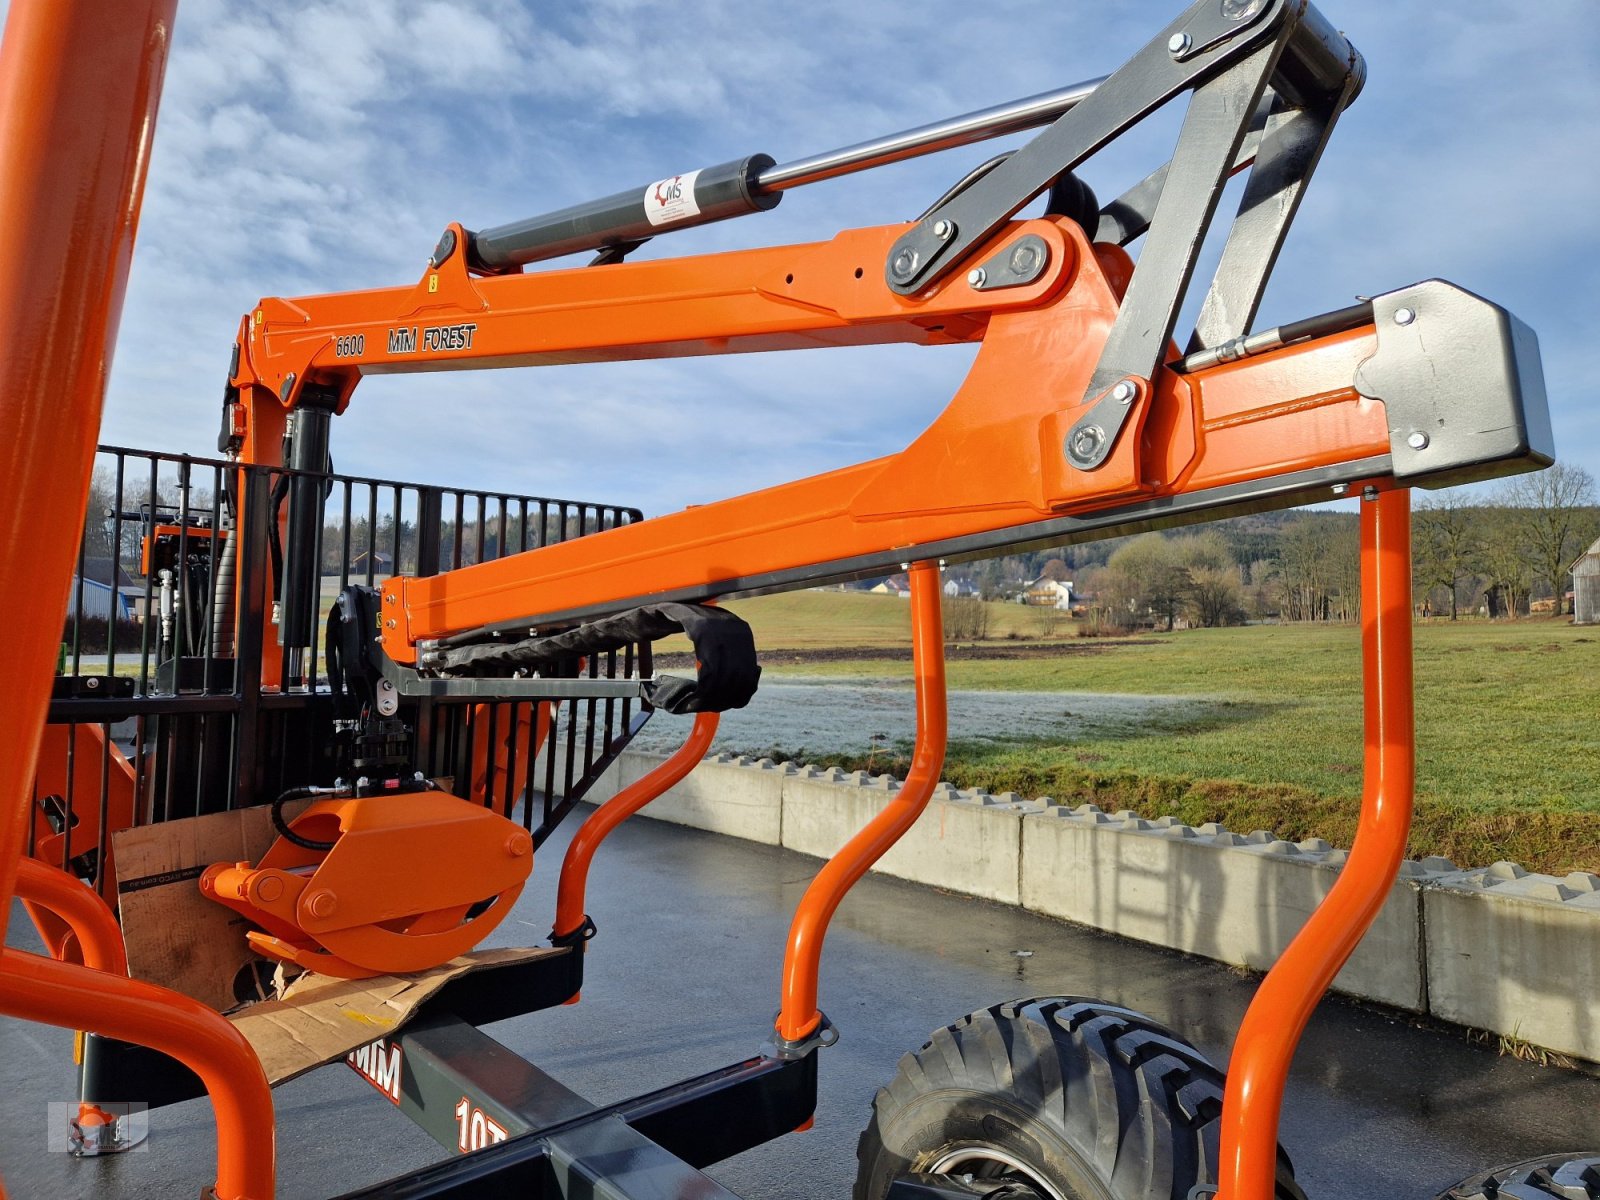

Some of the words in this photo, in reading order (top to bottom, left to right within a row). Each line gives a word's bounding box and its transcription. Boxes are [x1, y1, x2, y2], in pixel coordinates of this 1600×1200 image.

[336, 334, 364, 357] 6600
[387, 326, 418, 354] MTM
[422, 323, 477, 352] FOREST
